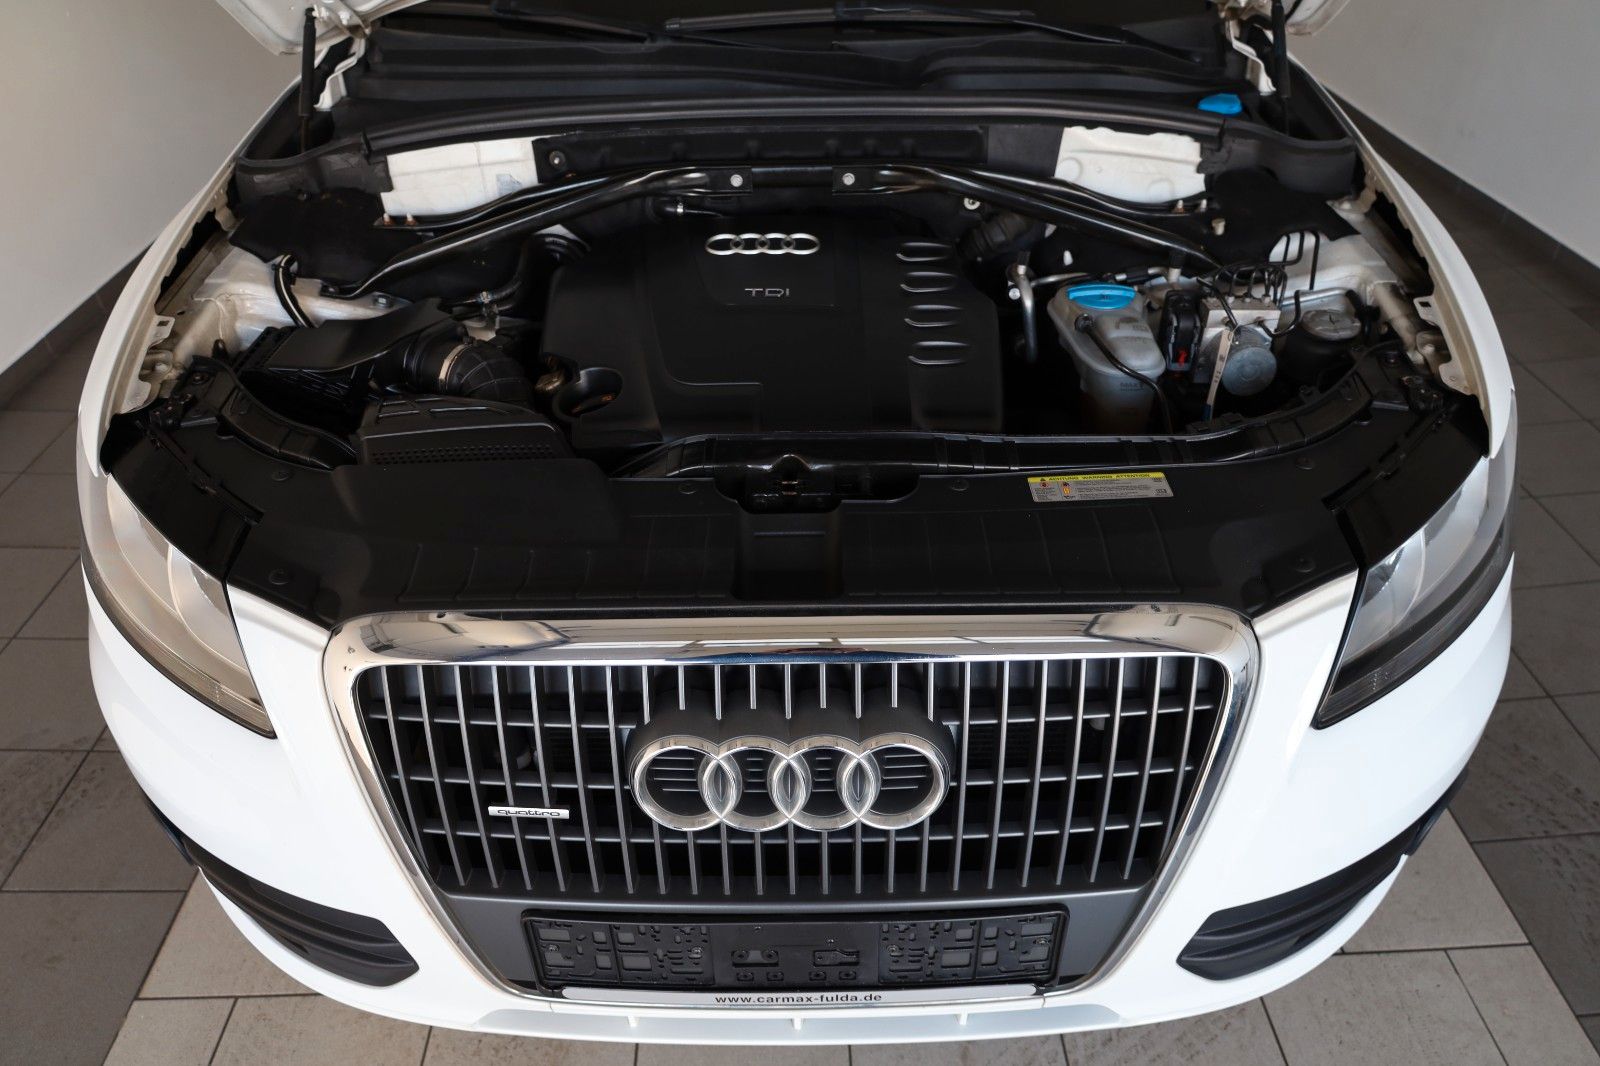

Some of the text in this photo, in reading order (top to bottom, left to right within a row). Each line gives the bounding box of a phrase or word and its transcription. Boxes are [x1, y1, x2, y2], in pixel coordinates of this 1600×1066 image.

[744, 288, 790, 297] TDI
[497, 809, 561, 817] quattro
[715, 993, 882, 1003] www.carmax-fulda.de
